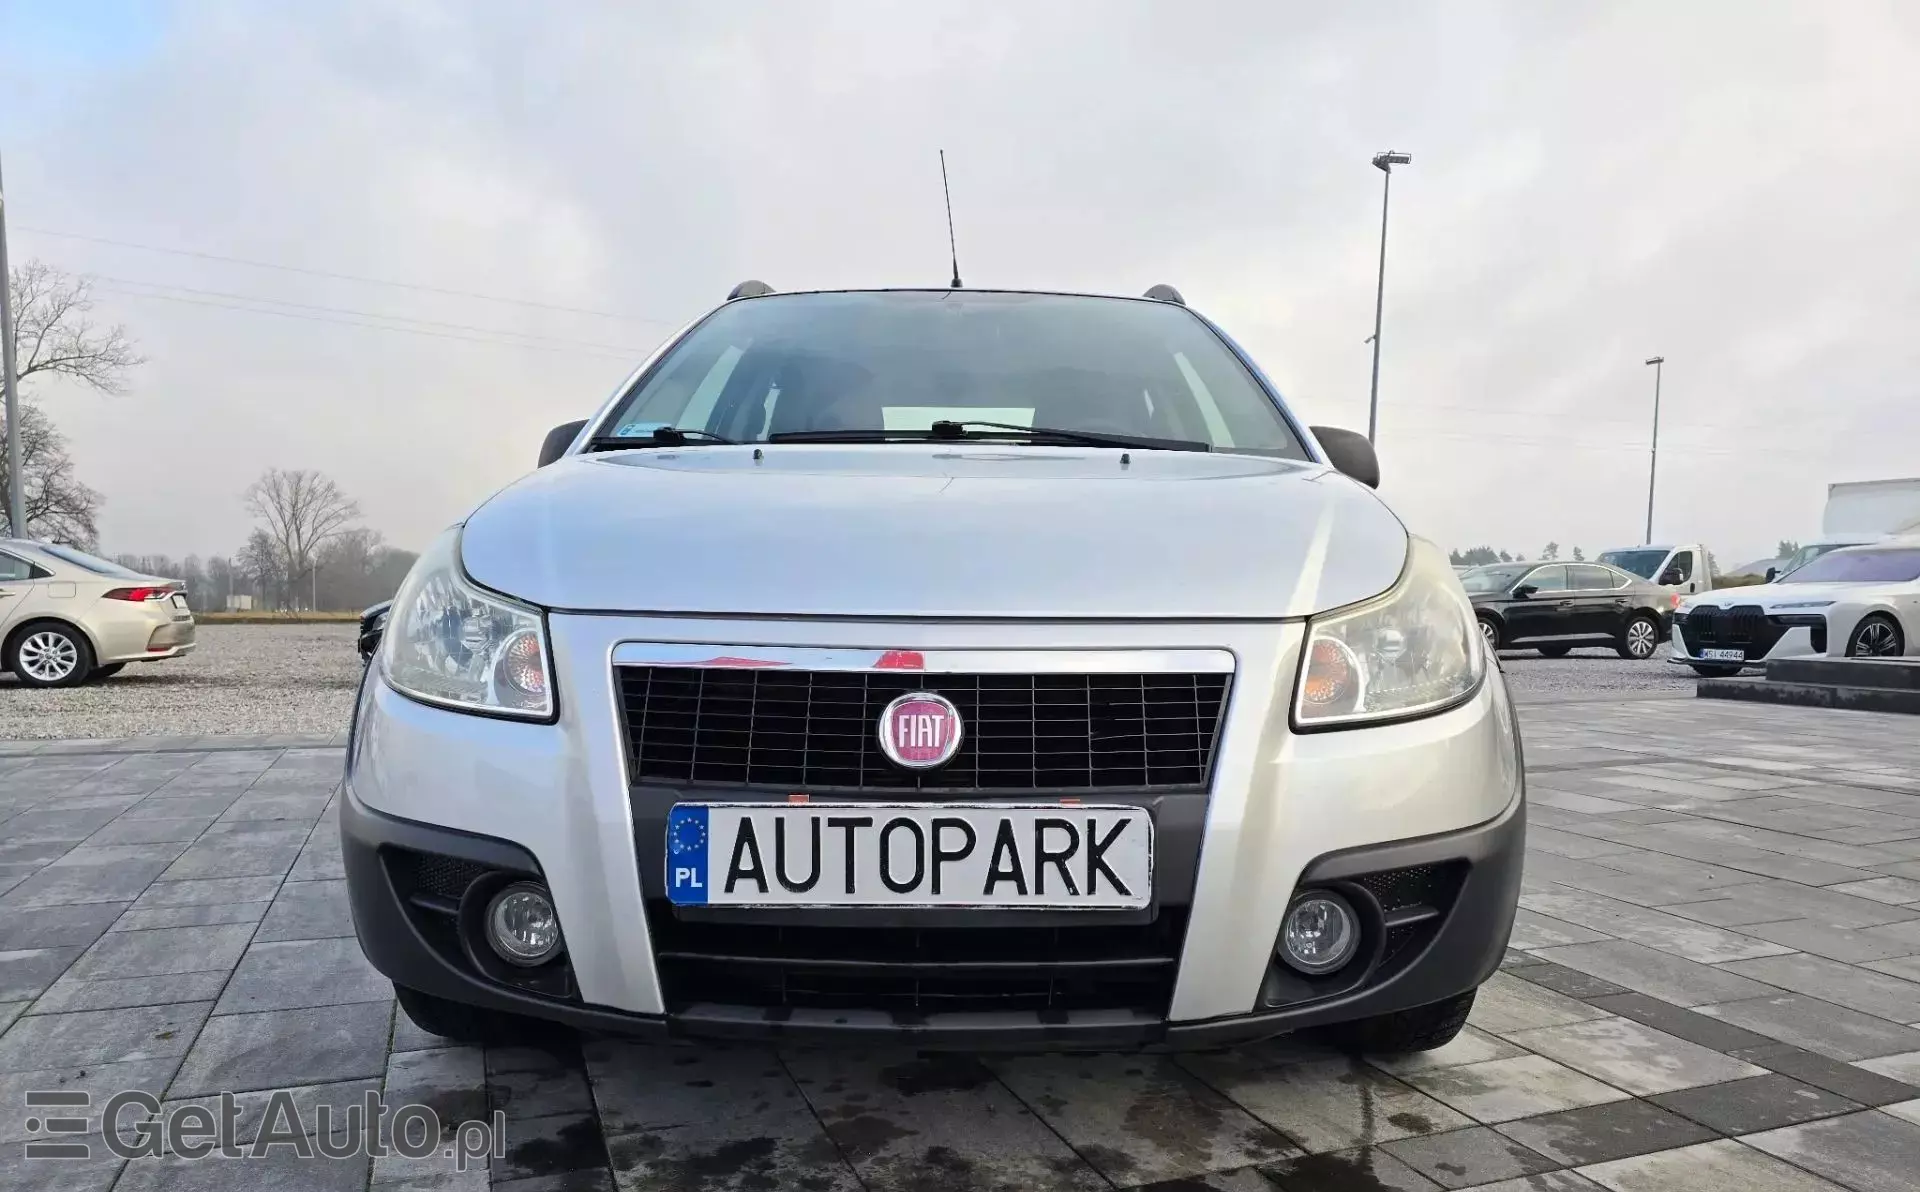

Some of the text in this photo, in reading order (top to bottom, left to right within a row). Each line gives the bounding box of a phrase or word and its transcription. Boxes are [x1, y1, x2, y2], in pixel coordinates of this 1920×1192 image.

[898, 714, 945, 748] FIAT
[724, 815, 1133, 896] AUTOPARK
[675, 867, 703, 888] PL
